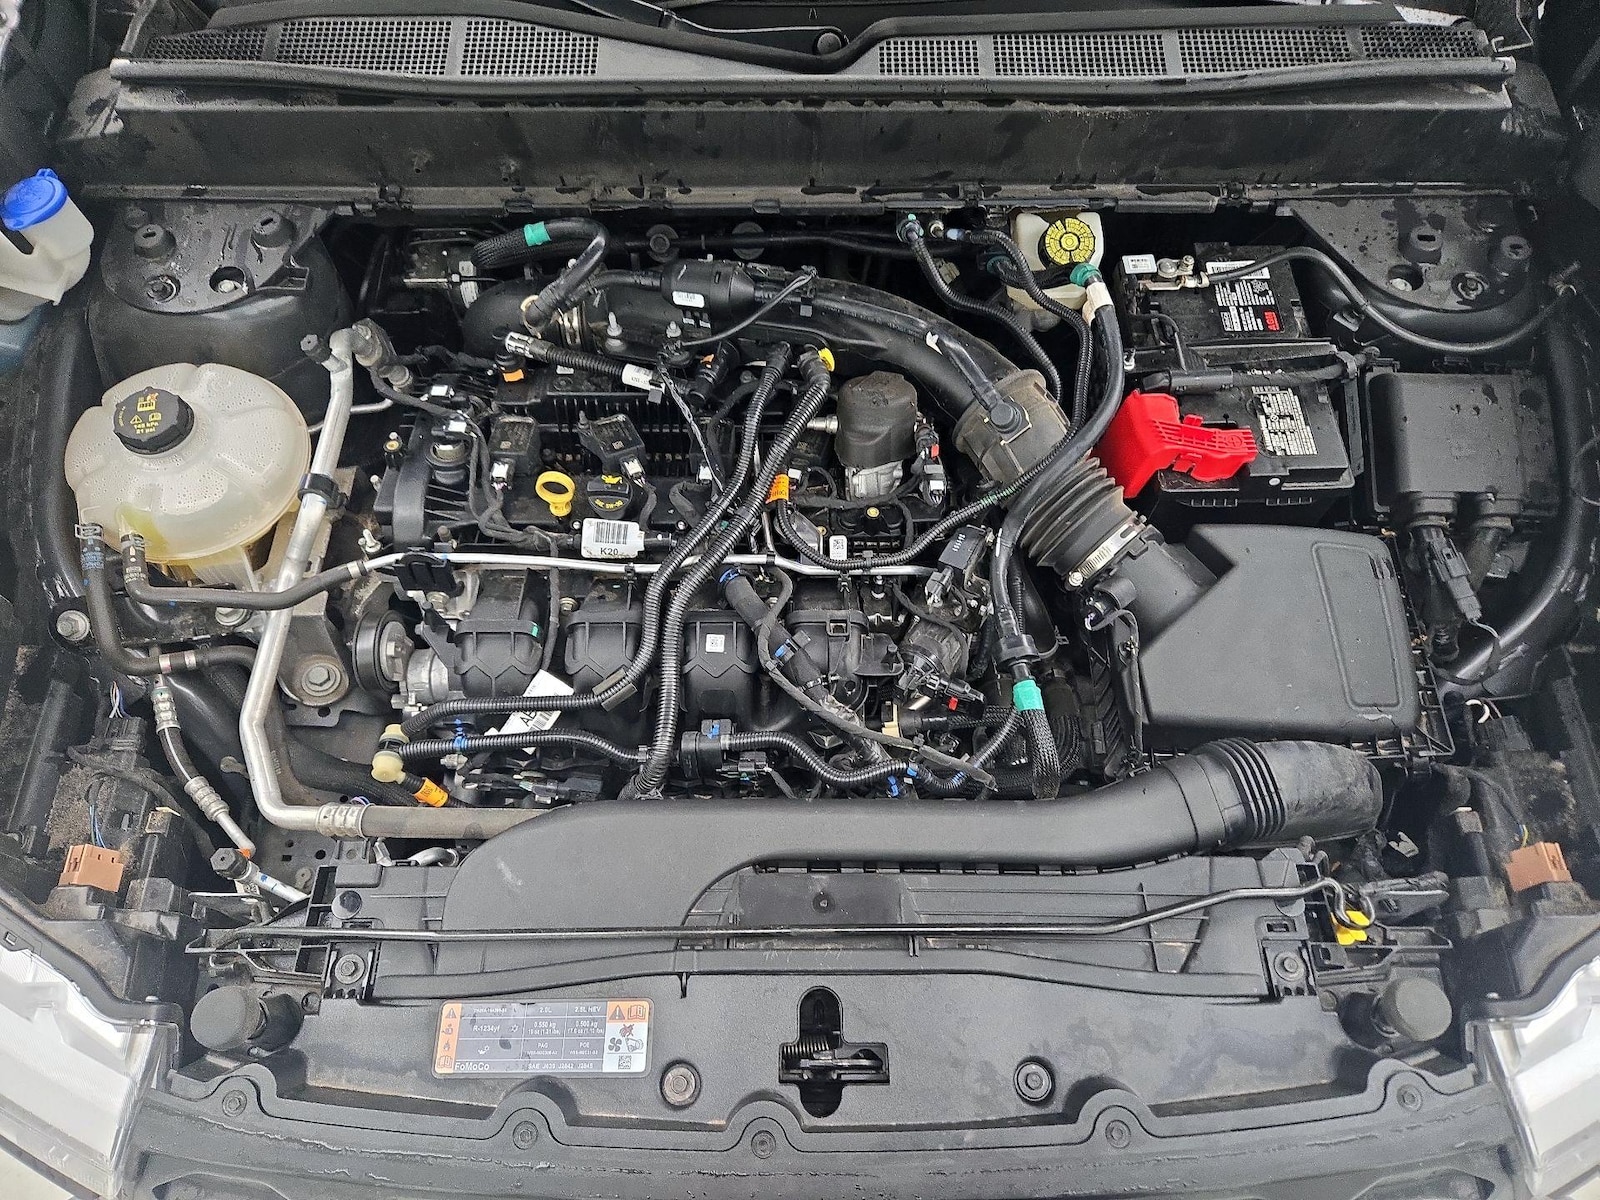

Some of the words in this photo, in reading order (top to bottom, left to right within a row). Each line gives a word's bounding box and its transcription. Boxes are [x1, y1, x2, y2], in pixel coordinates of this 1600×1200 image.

[600, 547, 619, 556] K20
[549, 1021, 557, 1029] kg
[590, 1020, 598, 1028] kg
[472, 1025, 501, 1033] R-1234yf
[455, 1062, 490, 1071] FoMoCo
